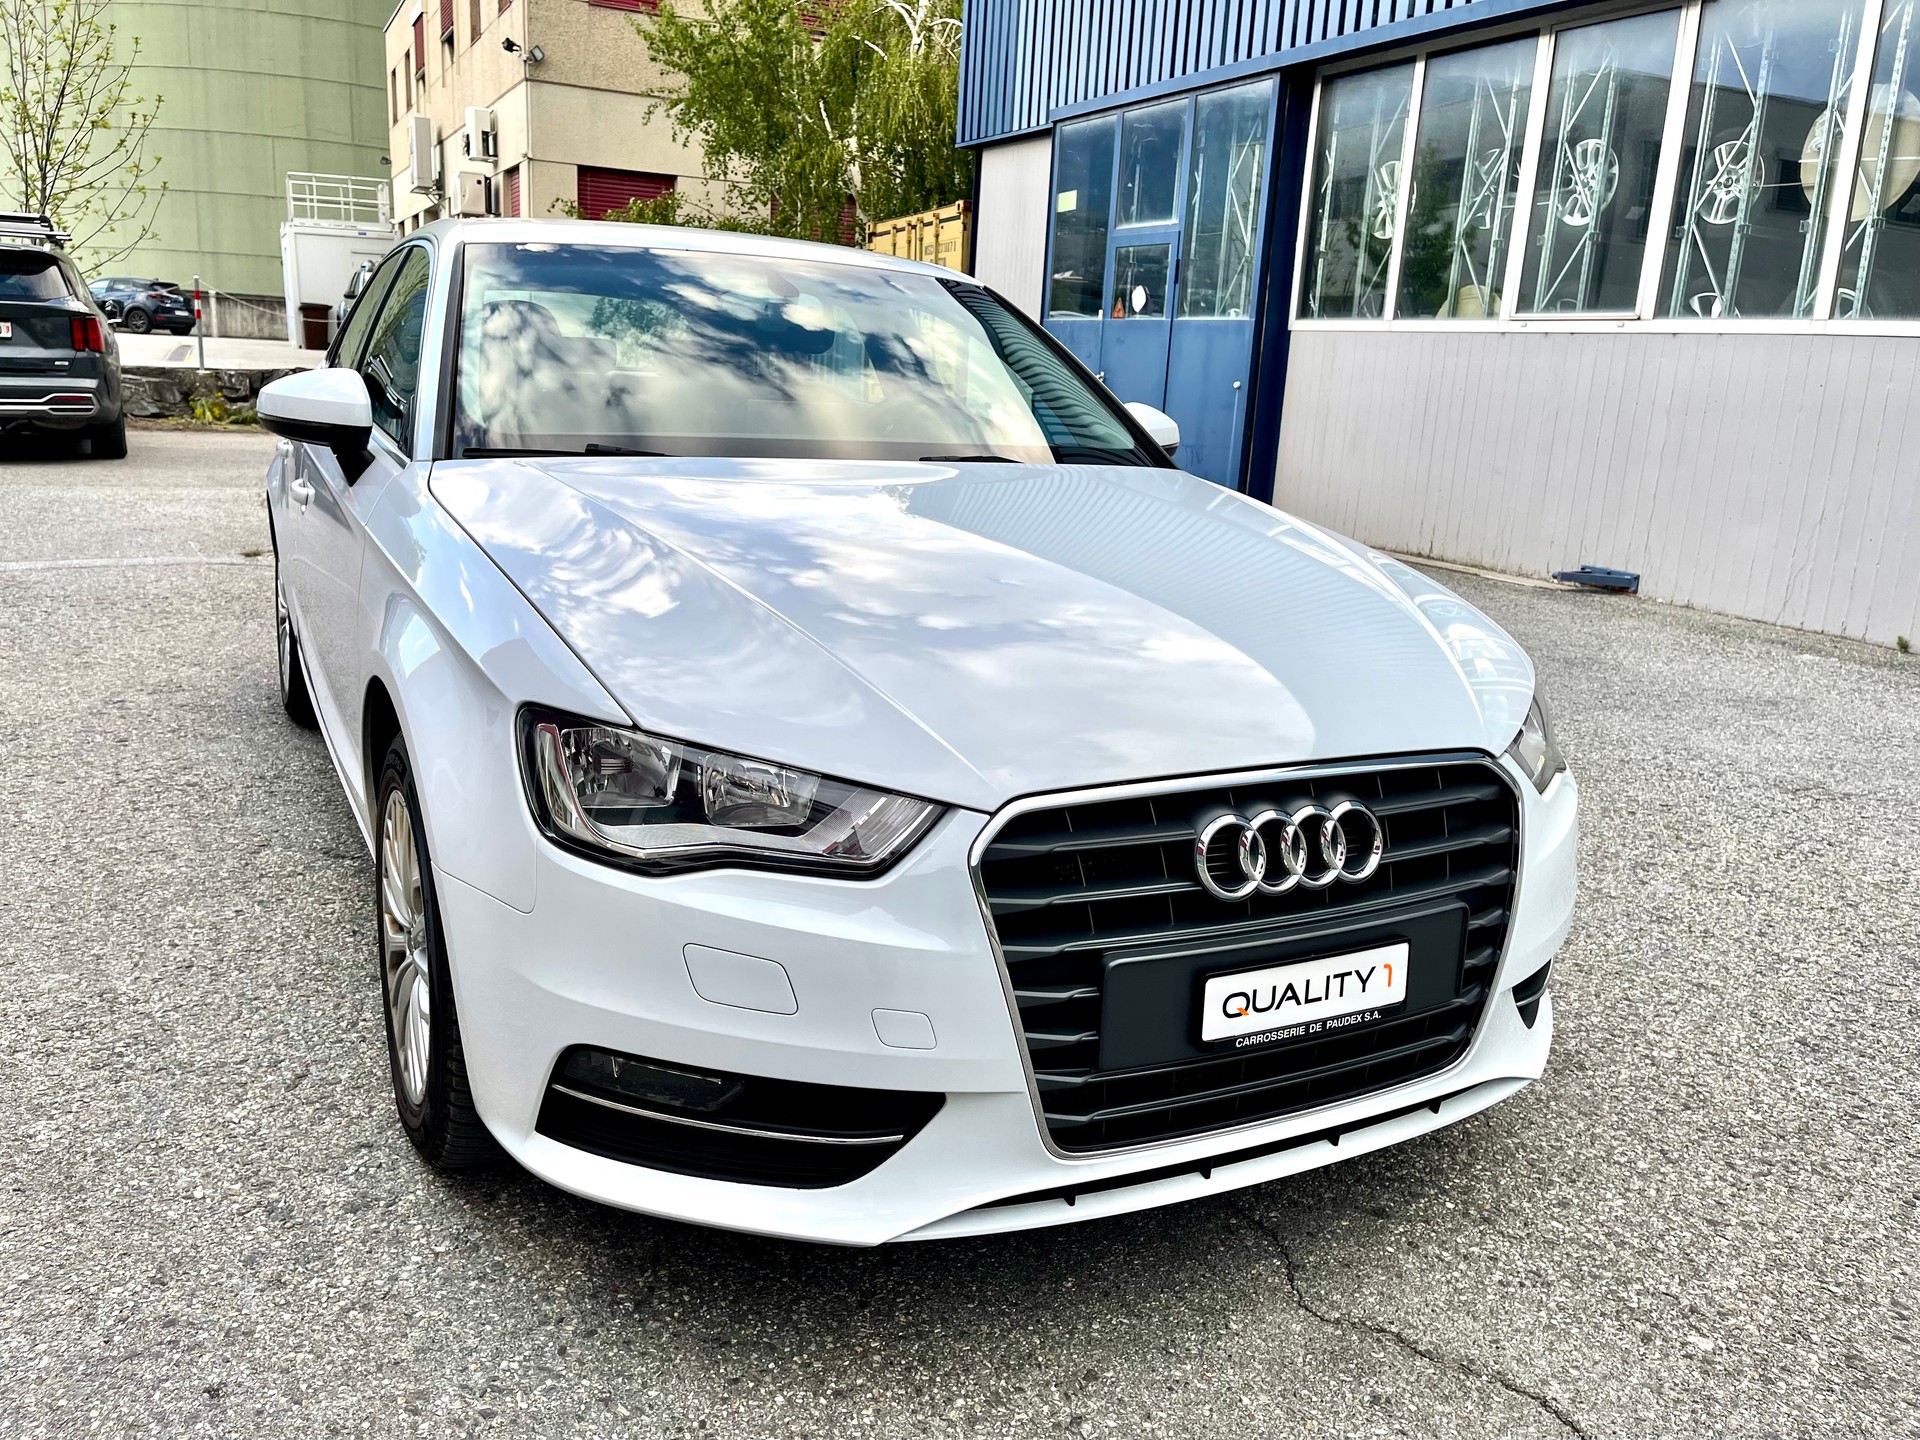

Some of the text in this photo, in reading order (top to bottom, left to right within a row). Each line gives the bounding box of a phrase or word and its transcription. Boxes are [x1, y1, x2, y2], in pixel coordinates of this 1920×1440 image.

[1222, 963, 1393, 1019] QUALITY 1
[1235, 1010, 1382, 1048] CARROSSERIE DE PAUDEX S.A.
